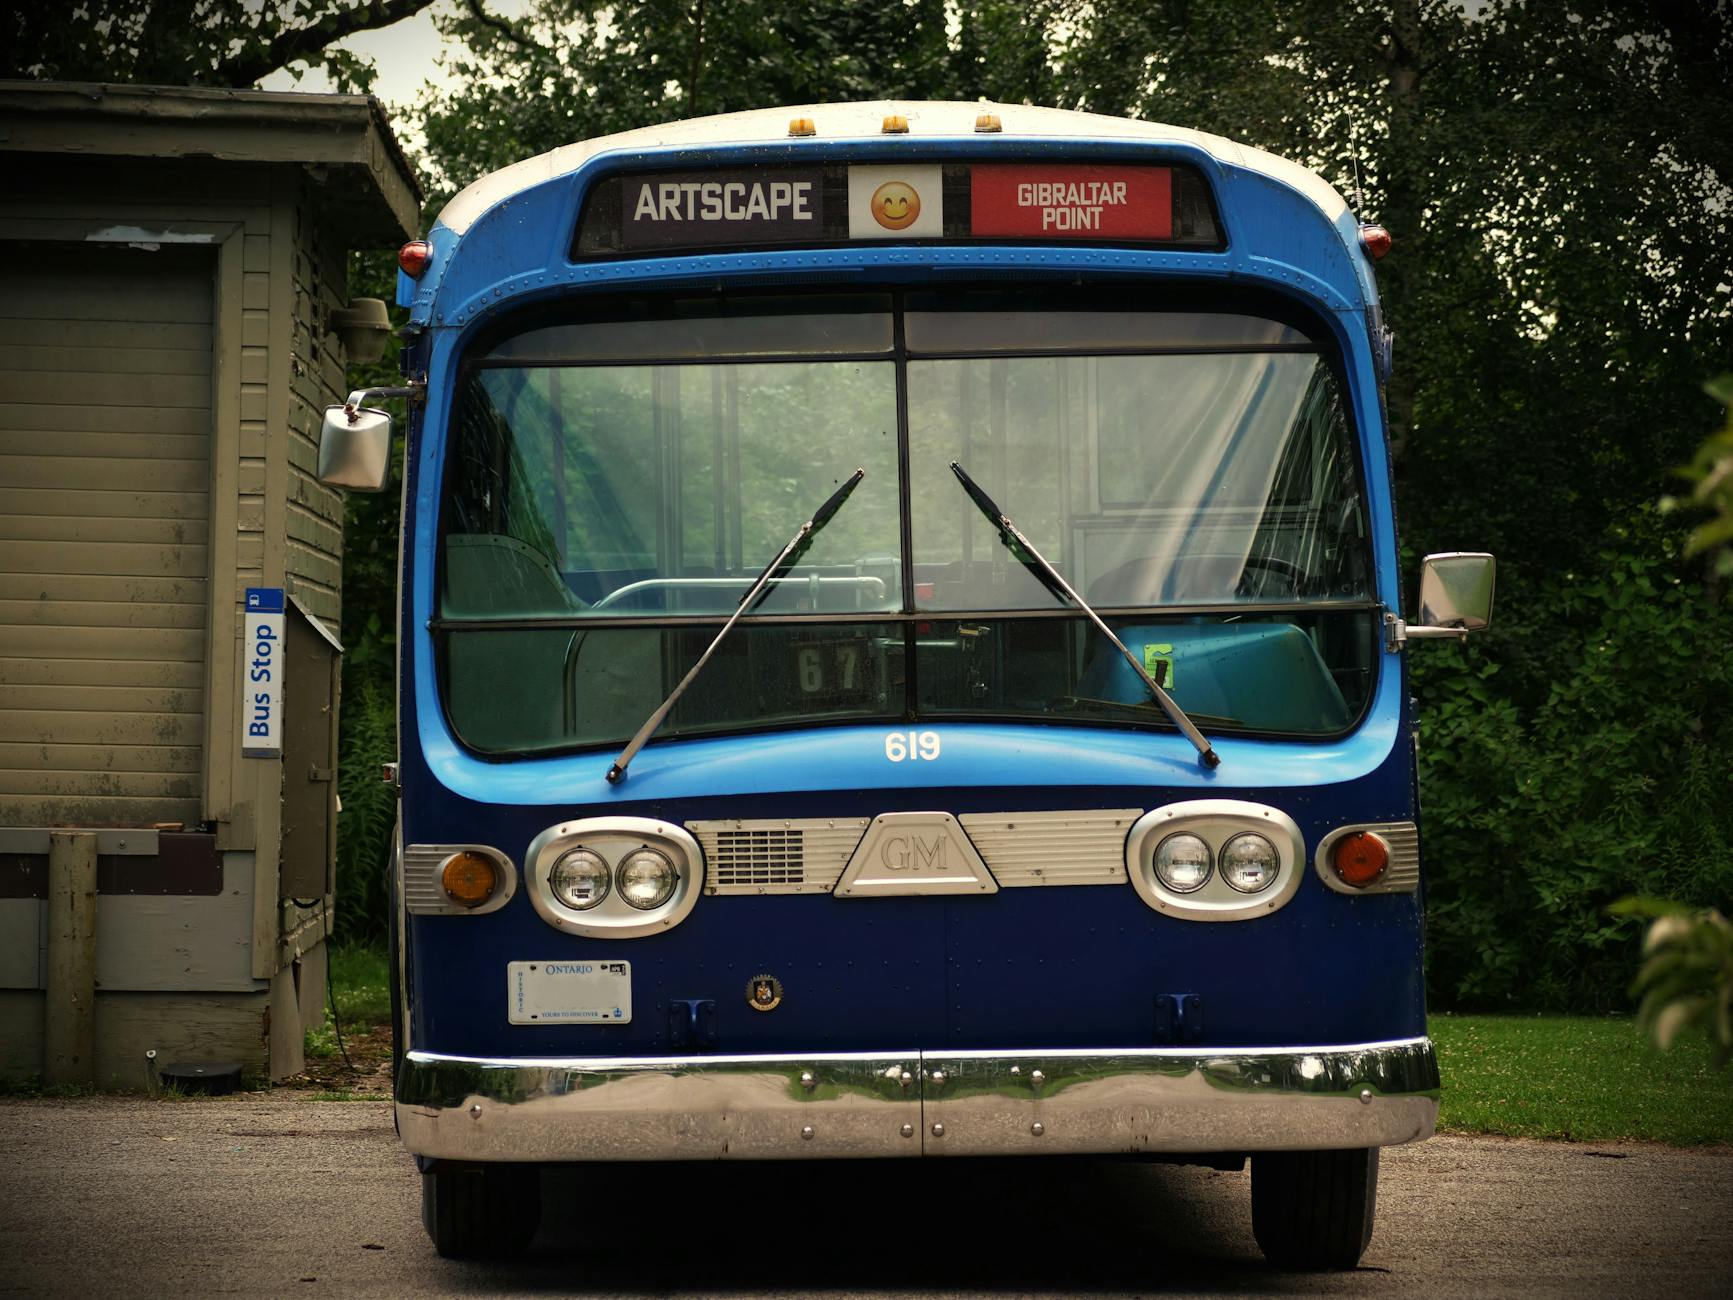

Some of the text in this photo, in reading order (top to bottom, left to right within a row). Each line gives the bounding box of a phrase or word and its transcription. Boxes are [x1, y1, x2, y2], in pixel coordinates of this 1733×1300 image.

[634, 182, 813, 221] ARTSCAPE
[1017, 182, 1127, 206] GIBRALTAR
[1042, 207, 1104, 230] POINT
[248, 624, 278, 737] Bus Stop
[885, 731, 941, 762] 619
[881, 833, 948, 871] GM
